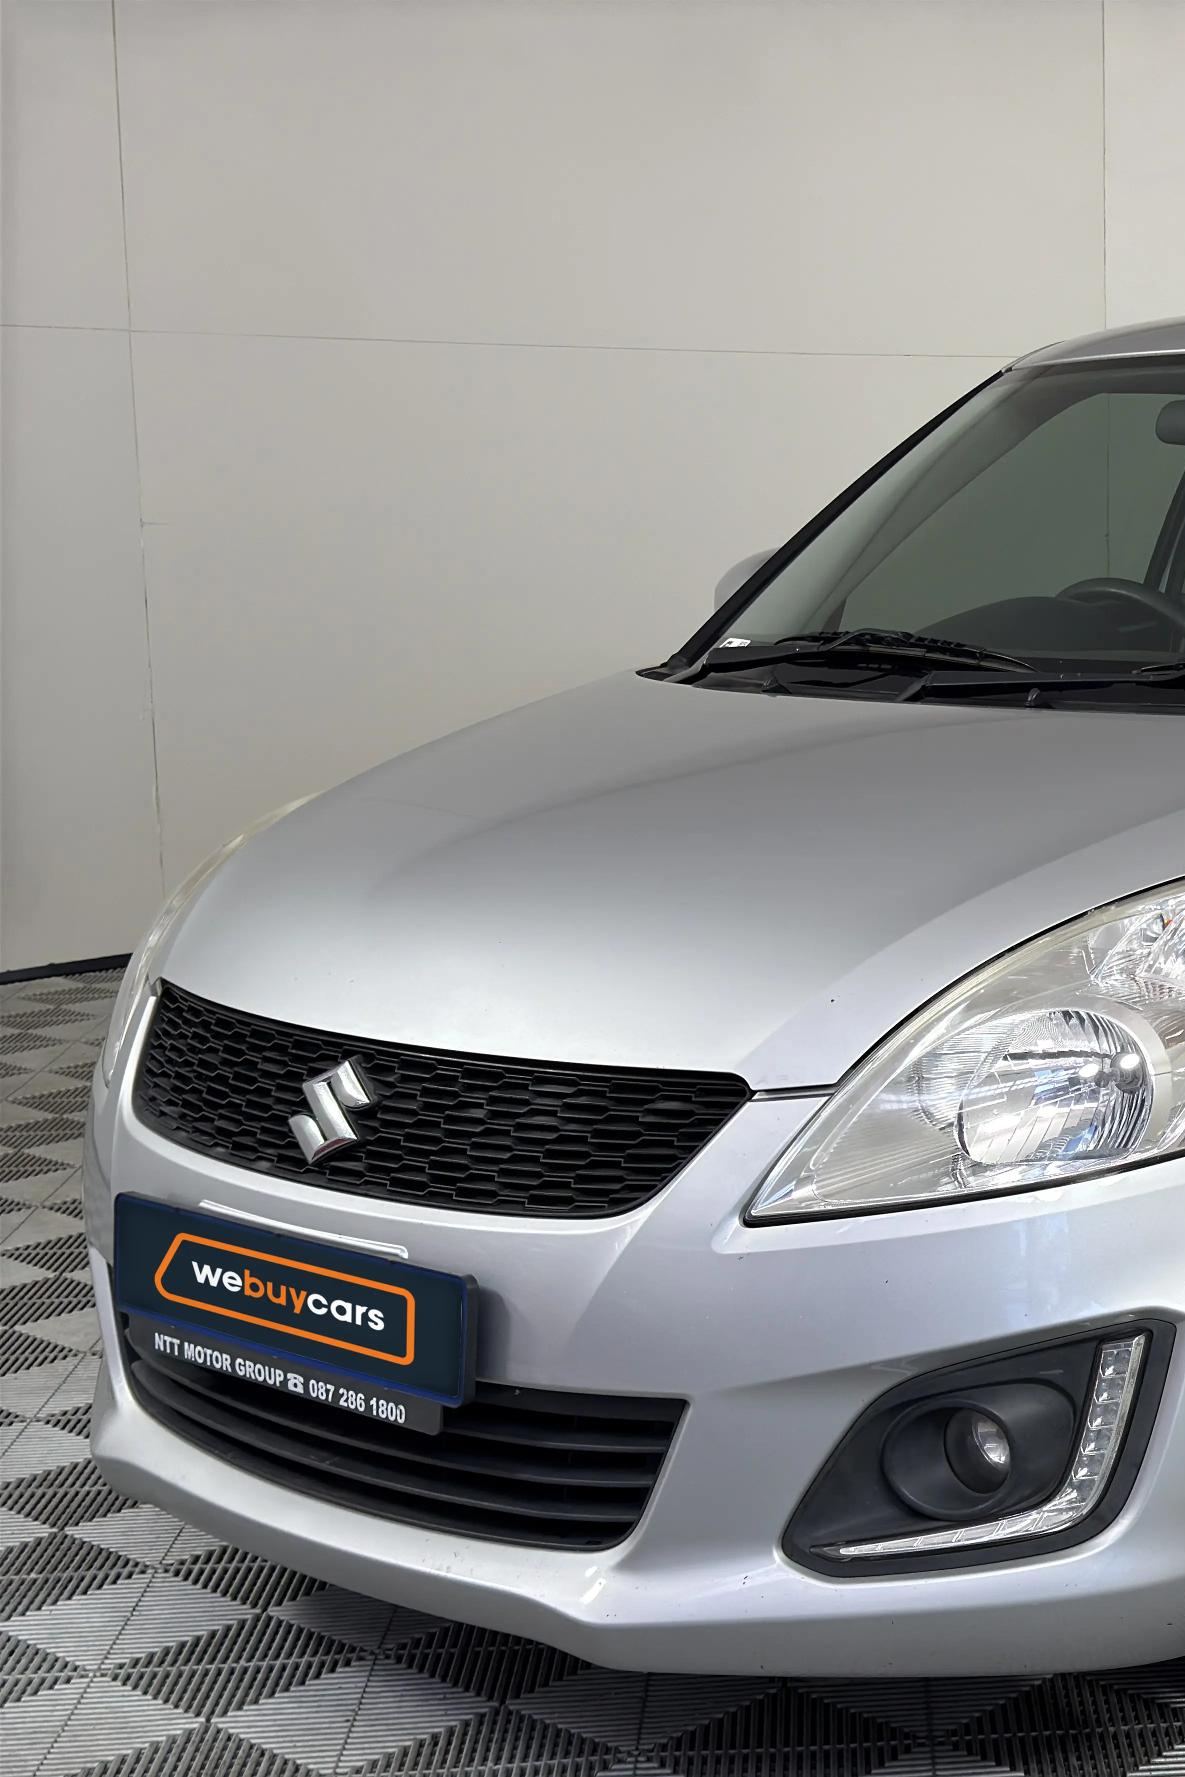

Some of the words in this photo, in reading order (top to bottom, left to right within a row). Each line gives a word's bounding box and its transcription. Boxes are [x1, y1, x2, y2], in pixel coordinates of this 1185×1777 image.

[154, 1332, 180, 1357] NTT
[183, 1342, 232, 1373] MOTOR
[235, 1356, 284, 1388] GROUP
[309, 1379, 333, 1404] 087
[339, 1387, 366, 1413] 286
[370, 1397, 406, 1425] 1800
